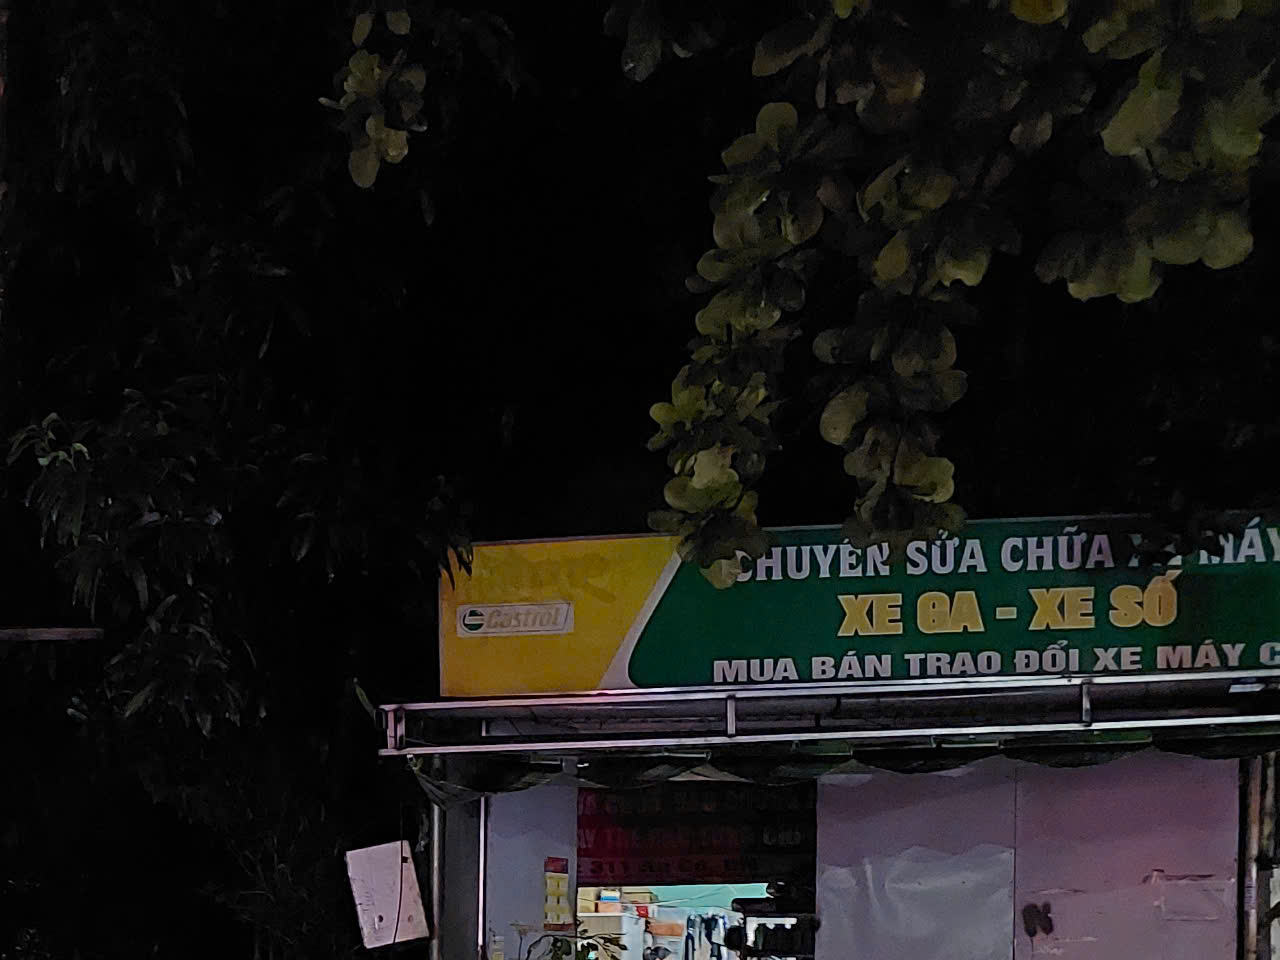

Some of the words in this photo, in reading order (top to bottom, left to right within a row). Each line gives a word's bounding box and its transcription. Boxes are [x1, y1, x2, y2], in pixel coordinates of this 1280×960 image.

[906, 528, 987, 576] SỬA
[1000, 525, 1115, 572] CHỮA
[837, 593, 903, 637] XE
[996, 606, 1017, 619] -
[1028, 586, 1095, 631] XE
[1109, 569, 1181, 628] SỐ
[713, 657, 798, 683] MUA
[811, 650, 891, 680] BÁN
[904, 651, 1001, 676] TRAO
[1015, 639, 1079, 673] ĐỔI
[1093, 646, 1141, 671] XE
[1156, 638, 1247, 670] MÁY
